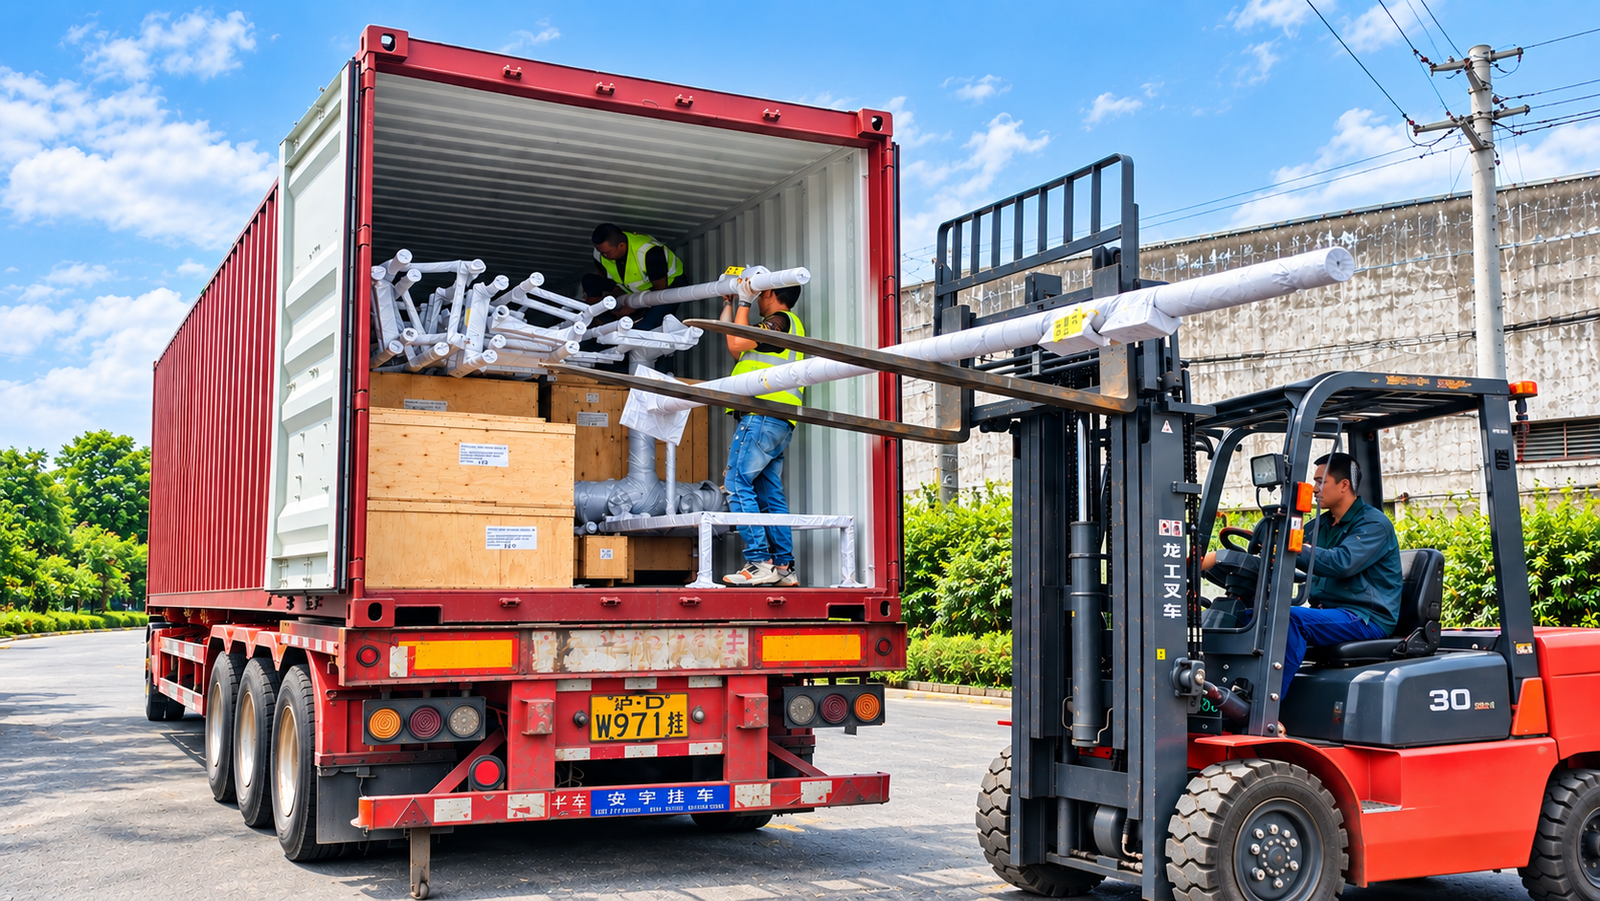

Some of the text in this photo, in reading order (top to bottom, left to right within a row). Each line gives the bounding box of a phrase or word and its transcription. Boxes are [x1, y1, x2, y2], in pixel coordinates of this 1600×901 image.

[1162, 542, 1182, 619] 龙工叉车
[1429, 688, 1471, 711] 30
